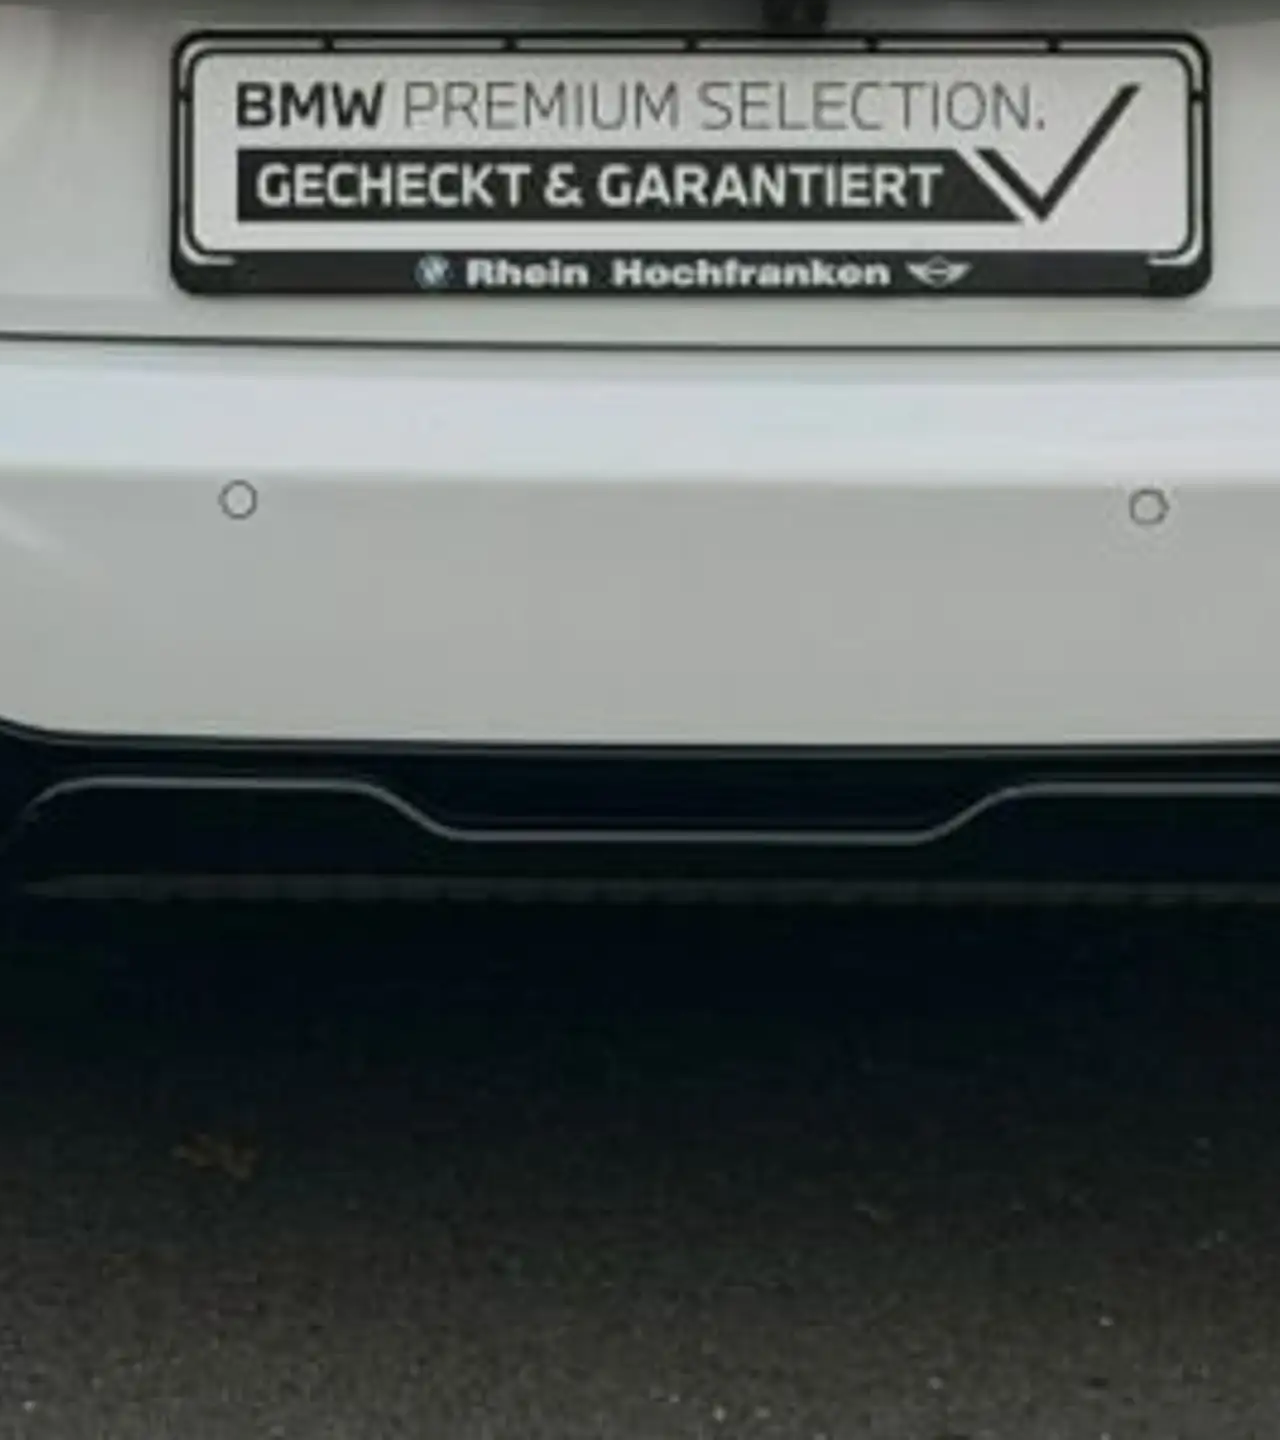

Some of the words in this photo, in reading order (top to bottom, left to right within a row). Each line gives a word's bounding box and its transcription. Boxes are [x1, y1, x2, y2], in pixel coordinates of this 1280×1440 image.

[236, 81, 385, 129] BMW
[404, 80, 679, 130] PREMIUM
[697, 80, 1046, 131] SELECTION.
[256, 162, 532, 208] GECHECKT
[543, 162, 584, 208] &
[596, 162, 944, 208] GARANTIERT
[466, 258, 590, 288] Rhein
[611, 258, 891, 288] Hochfranken
